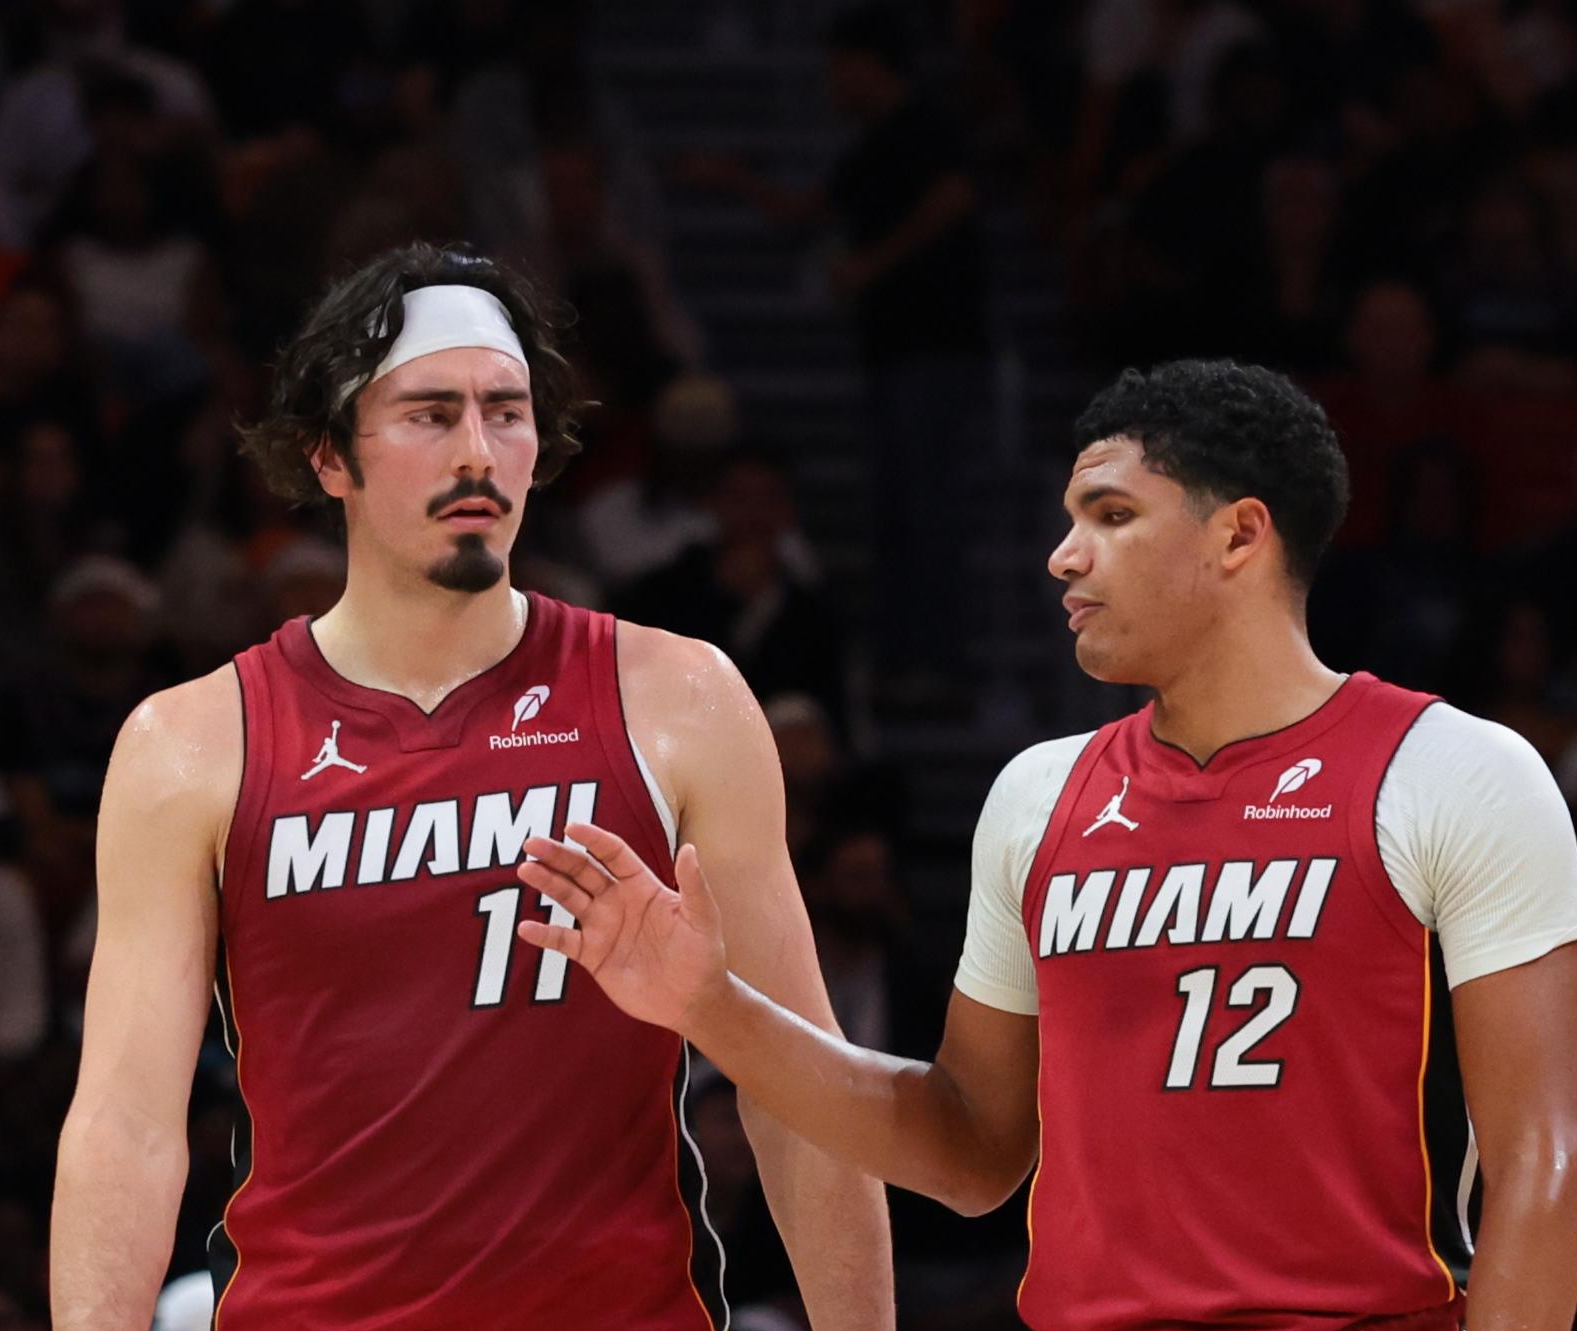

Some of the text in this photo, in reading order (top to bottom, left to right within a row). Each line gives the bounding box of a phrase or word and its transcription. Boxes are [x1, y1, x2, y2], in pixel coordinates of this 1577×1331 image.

[489, 728, 579, 751] Robinhood
[265, 780, 599, 899] MIAMI
[1243, 804, 1332, 820] Robinhood
[1038, 858, 1340, 959] MIAMI
[1163, 962, 1301, 1091] 12
